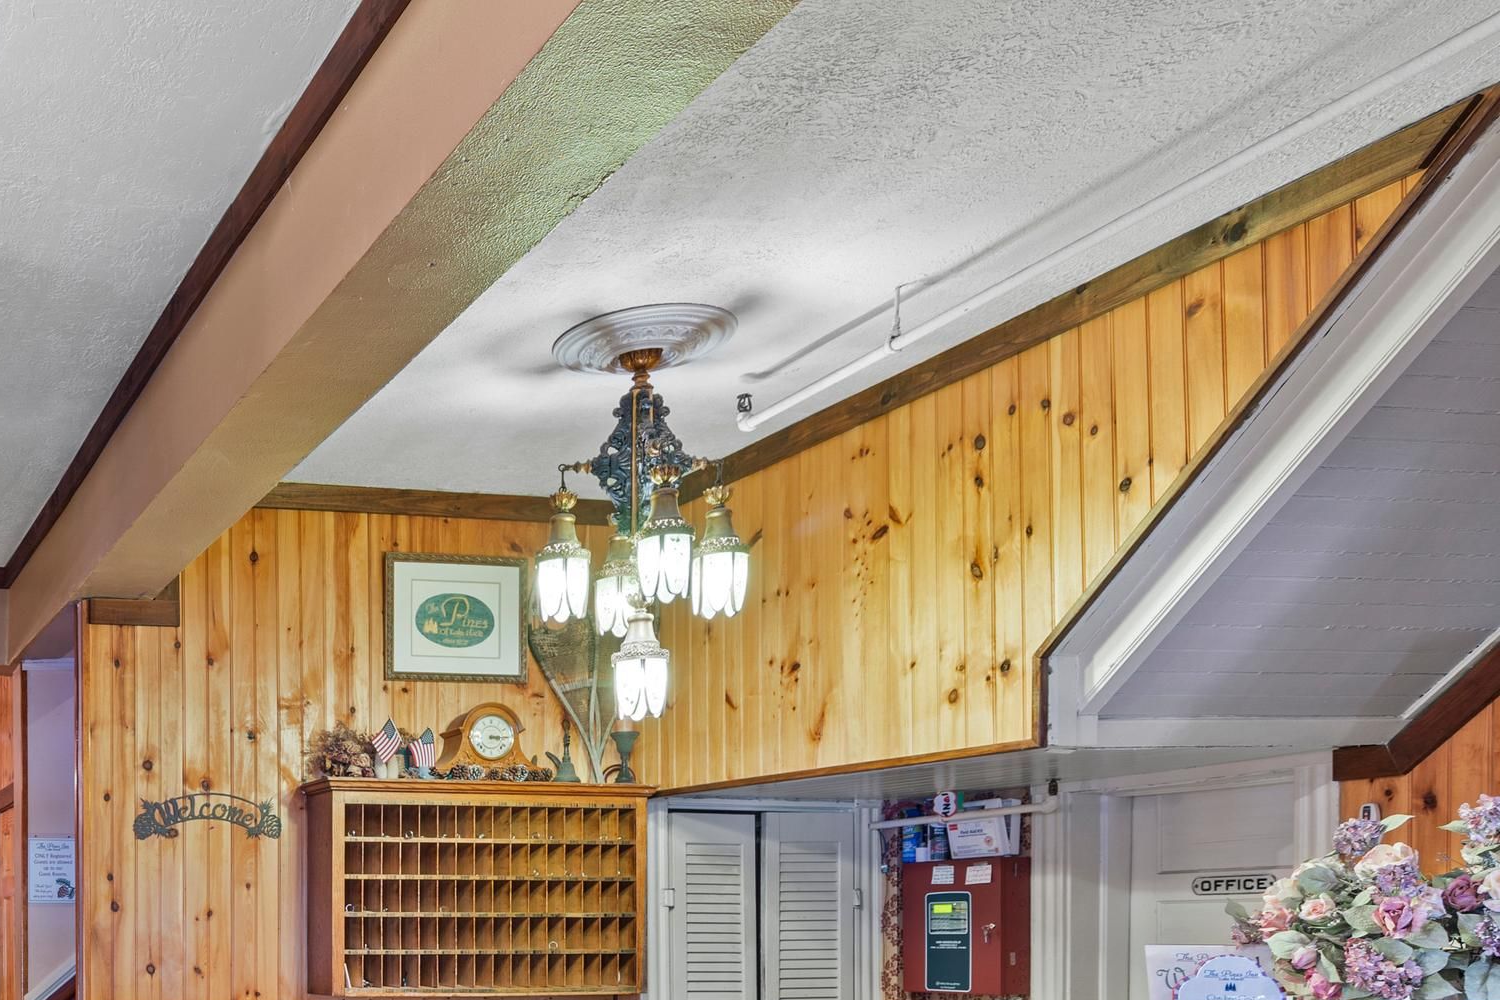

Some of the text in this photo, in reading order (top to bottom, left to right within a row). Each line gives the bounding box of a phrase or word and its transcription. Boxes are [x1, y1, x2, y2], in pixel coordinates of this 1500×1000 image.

[439, 596, 489, 629] Pines
[153, 795, 255, 827] Welcome
[1200, 878, 1268, 892] OFFICE
[1203, 969, 1259, 978] The Pines Inn
